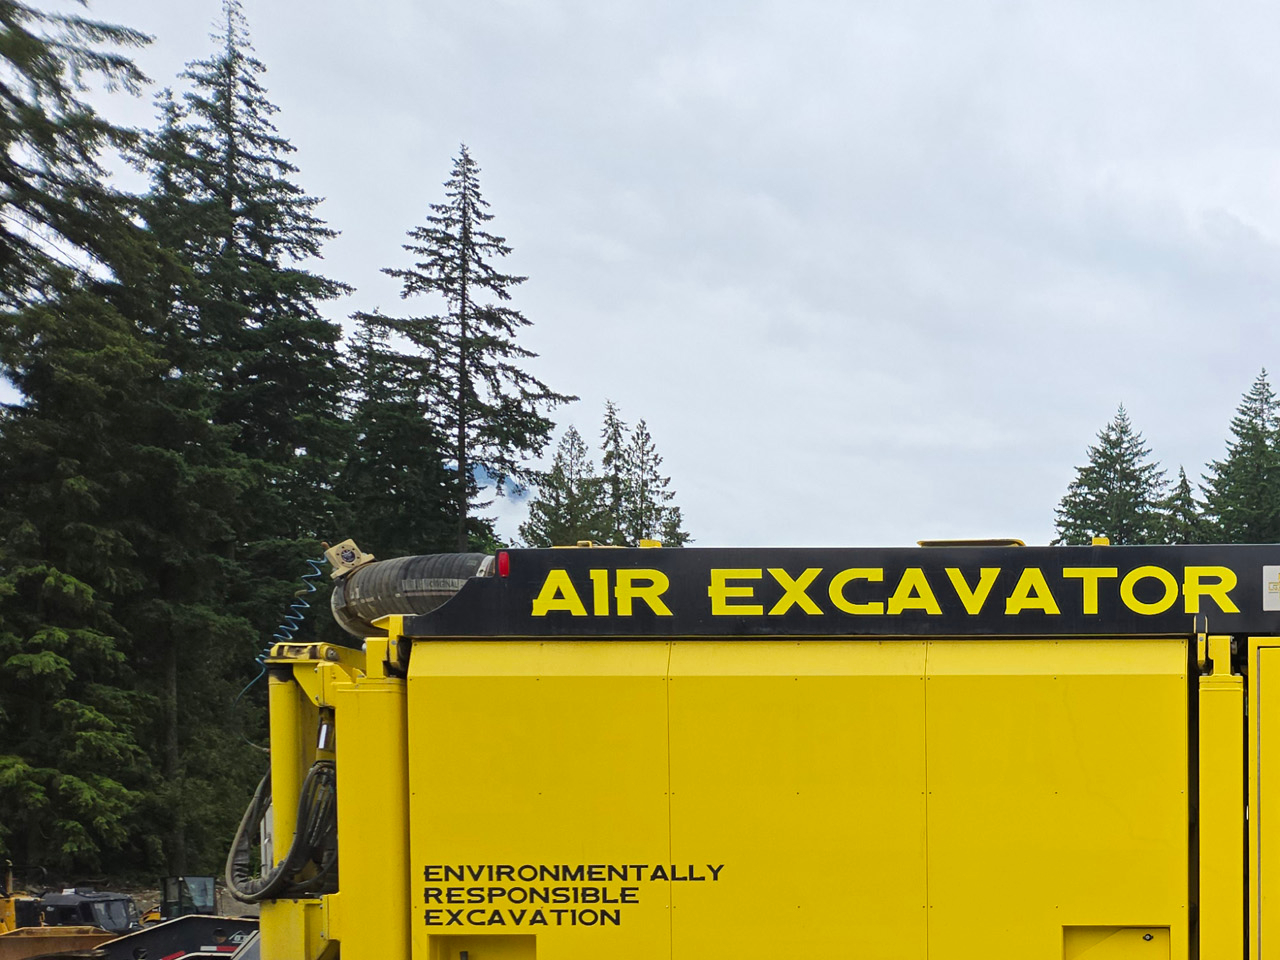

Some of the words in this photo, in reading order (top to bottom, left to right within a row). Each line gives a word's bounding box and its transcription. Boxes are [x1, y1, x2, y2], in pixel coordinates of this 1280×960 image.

[532, 568, 673, 616] AIR
[708, 565, 1240, 616] EXCAVATOR
[423, 865, 725, 882] ENVIRONMENTALLY
[423, 887, 640, 904] RESPONSIBLE
[424, 909, 621, 926] EXCAVATION
